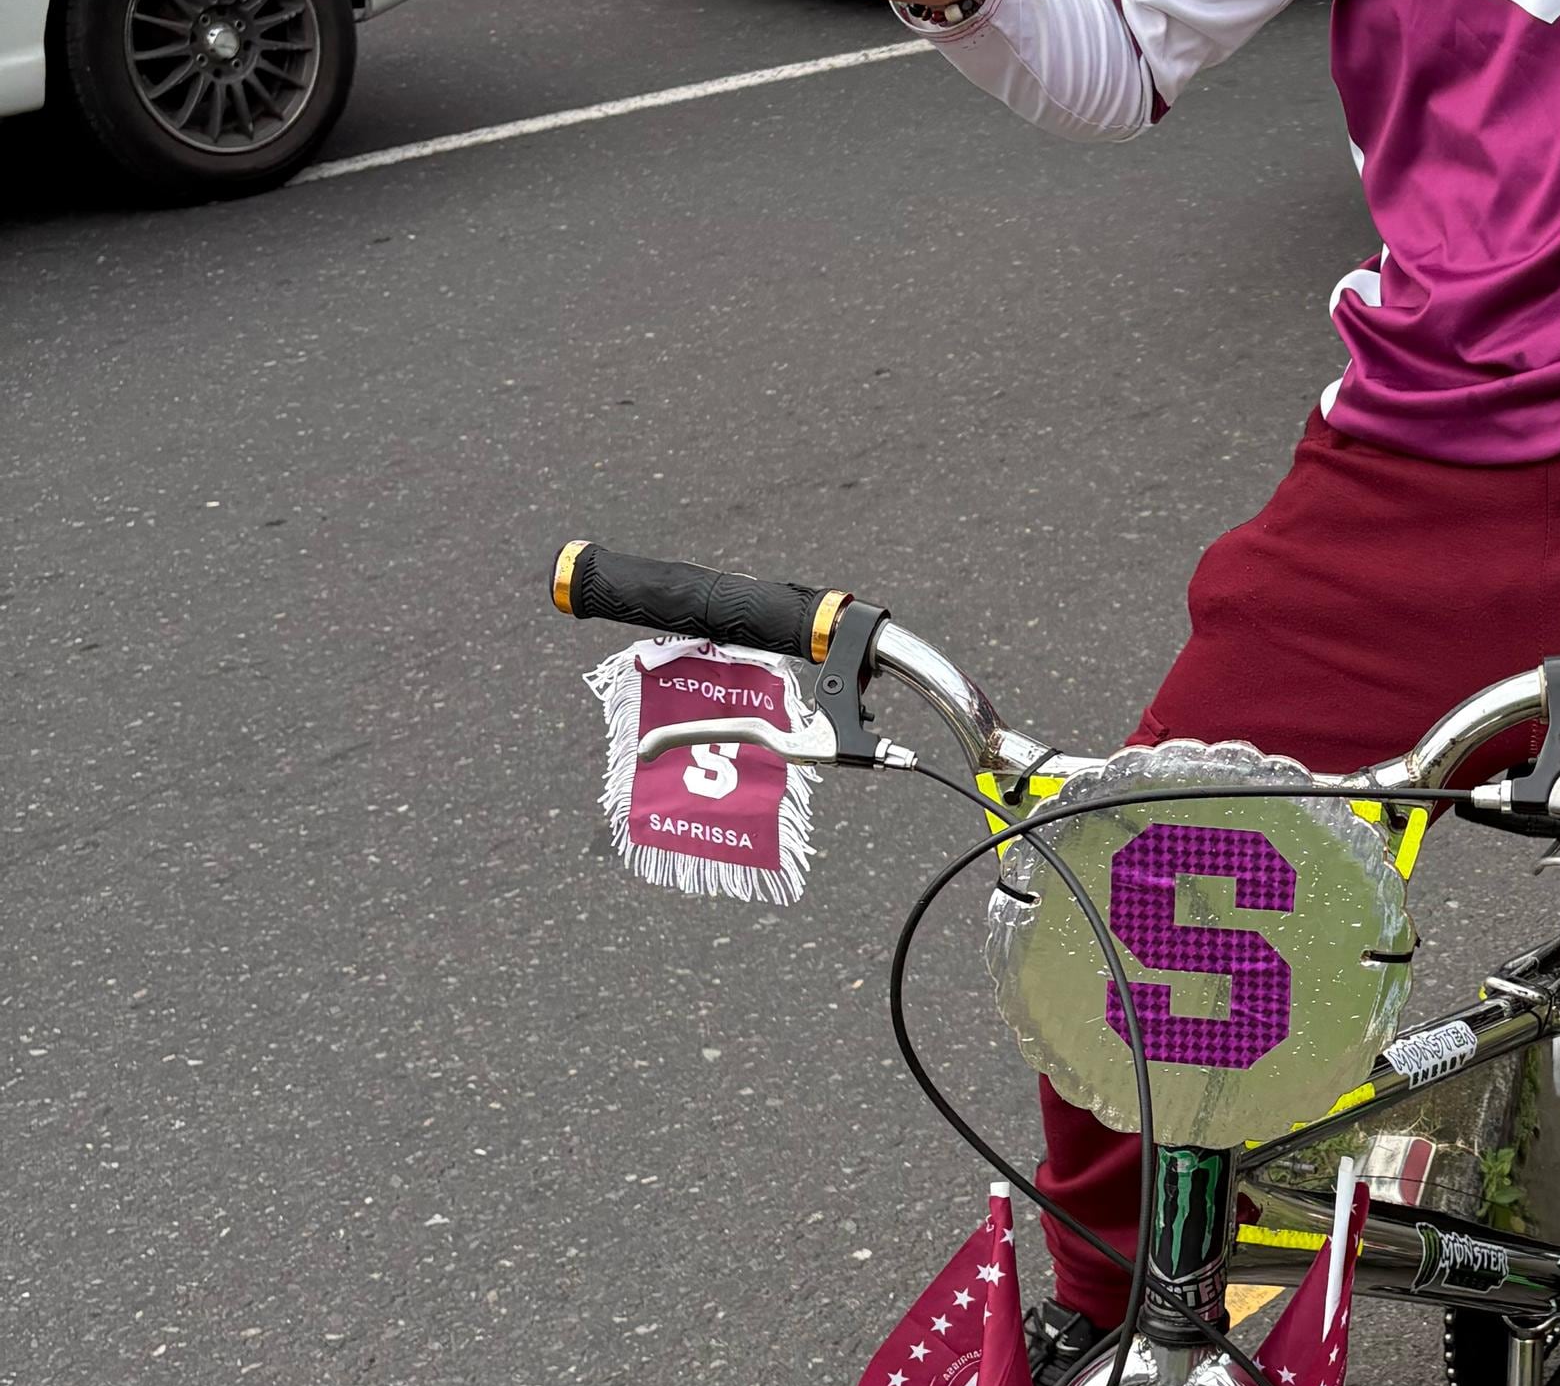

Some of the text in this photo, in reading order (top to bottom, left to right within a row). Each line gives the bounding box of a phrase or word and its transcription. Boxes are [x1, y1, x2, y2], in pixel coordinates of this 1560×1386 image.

[659, 677, 775, 711] DEPORTIVO
[683, 742, 741, 800] S
[649, 813, 754, 850] SAPRISSA
[1105, 823, 1297, 1070] S
[1387, 1027, 1476, 1072] MONSTER
[1441, 1236, 1507, 1276] MONSTER
